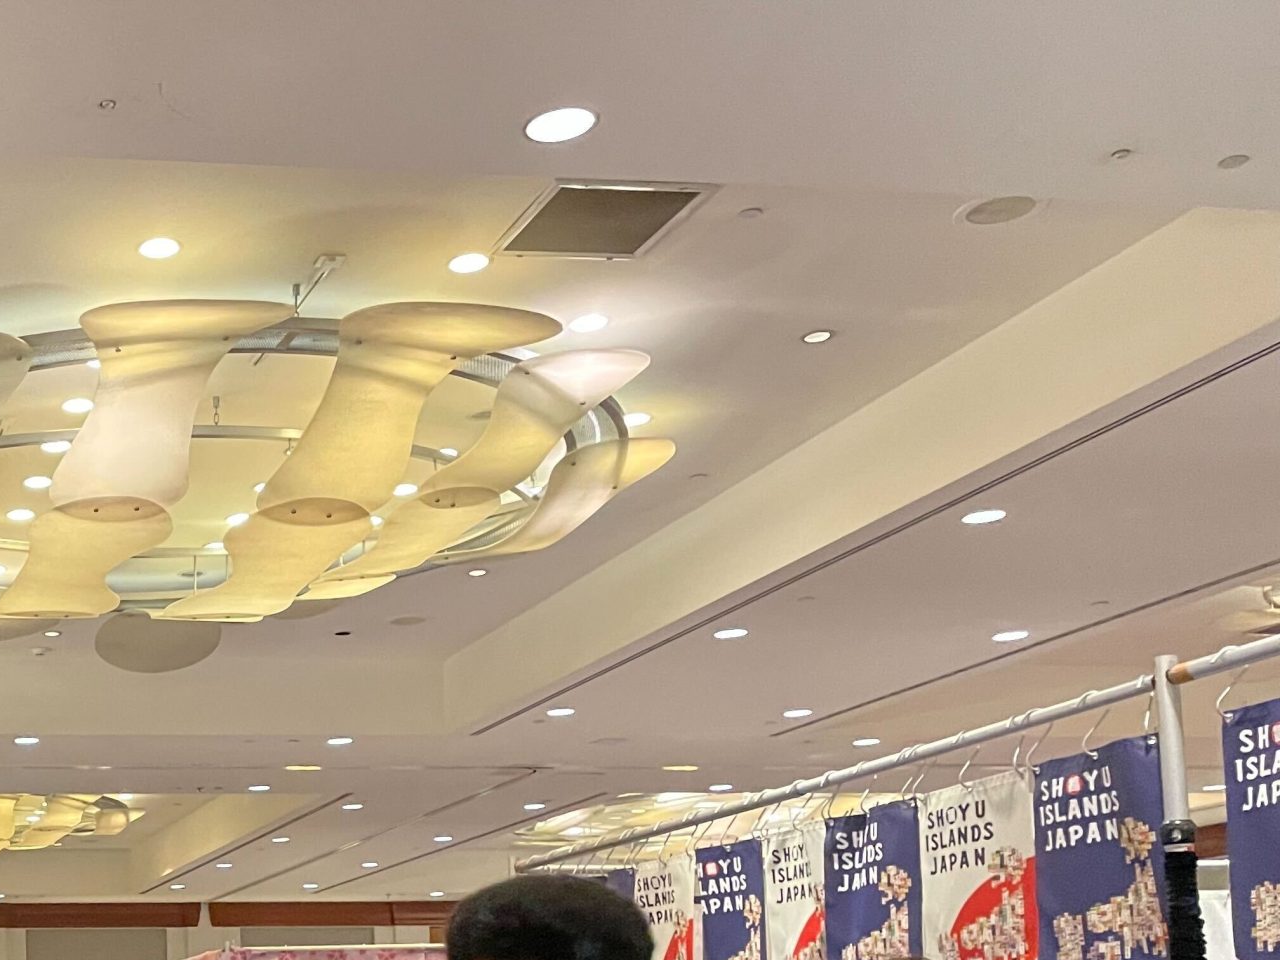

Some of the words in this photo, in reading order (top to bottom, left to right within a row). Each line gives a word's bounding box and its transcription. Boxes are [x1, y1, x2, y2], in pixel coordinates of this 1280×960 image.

[1235, 750, 1280, 782] ISLA
[1039, 790, 1120, 826] ISLANDS
[1242, 780, 1280, 812] JAP
[927, 800, 986, 830] SHOYU
[925, 822, 994, 852] ISLANDS
[1045, 818, 1120, 852] JAPAN
[696, 856, 742, 878] HOYU
[771, 843, 807, 865] SHOY
[930, 847, 986, 875] JAPAN
[699, 874, 747, 896] LANDS
[648, 909, 673, 925] APAN
[700, 895, 744, 915] APAN
